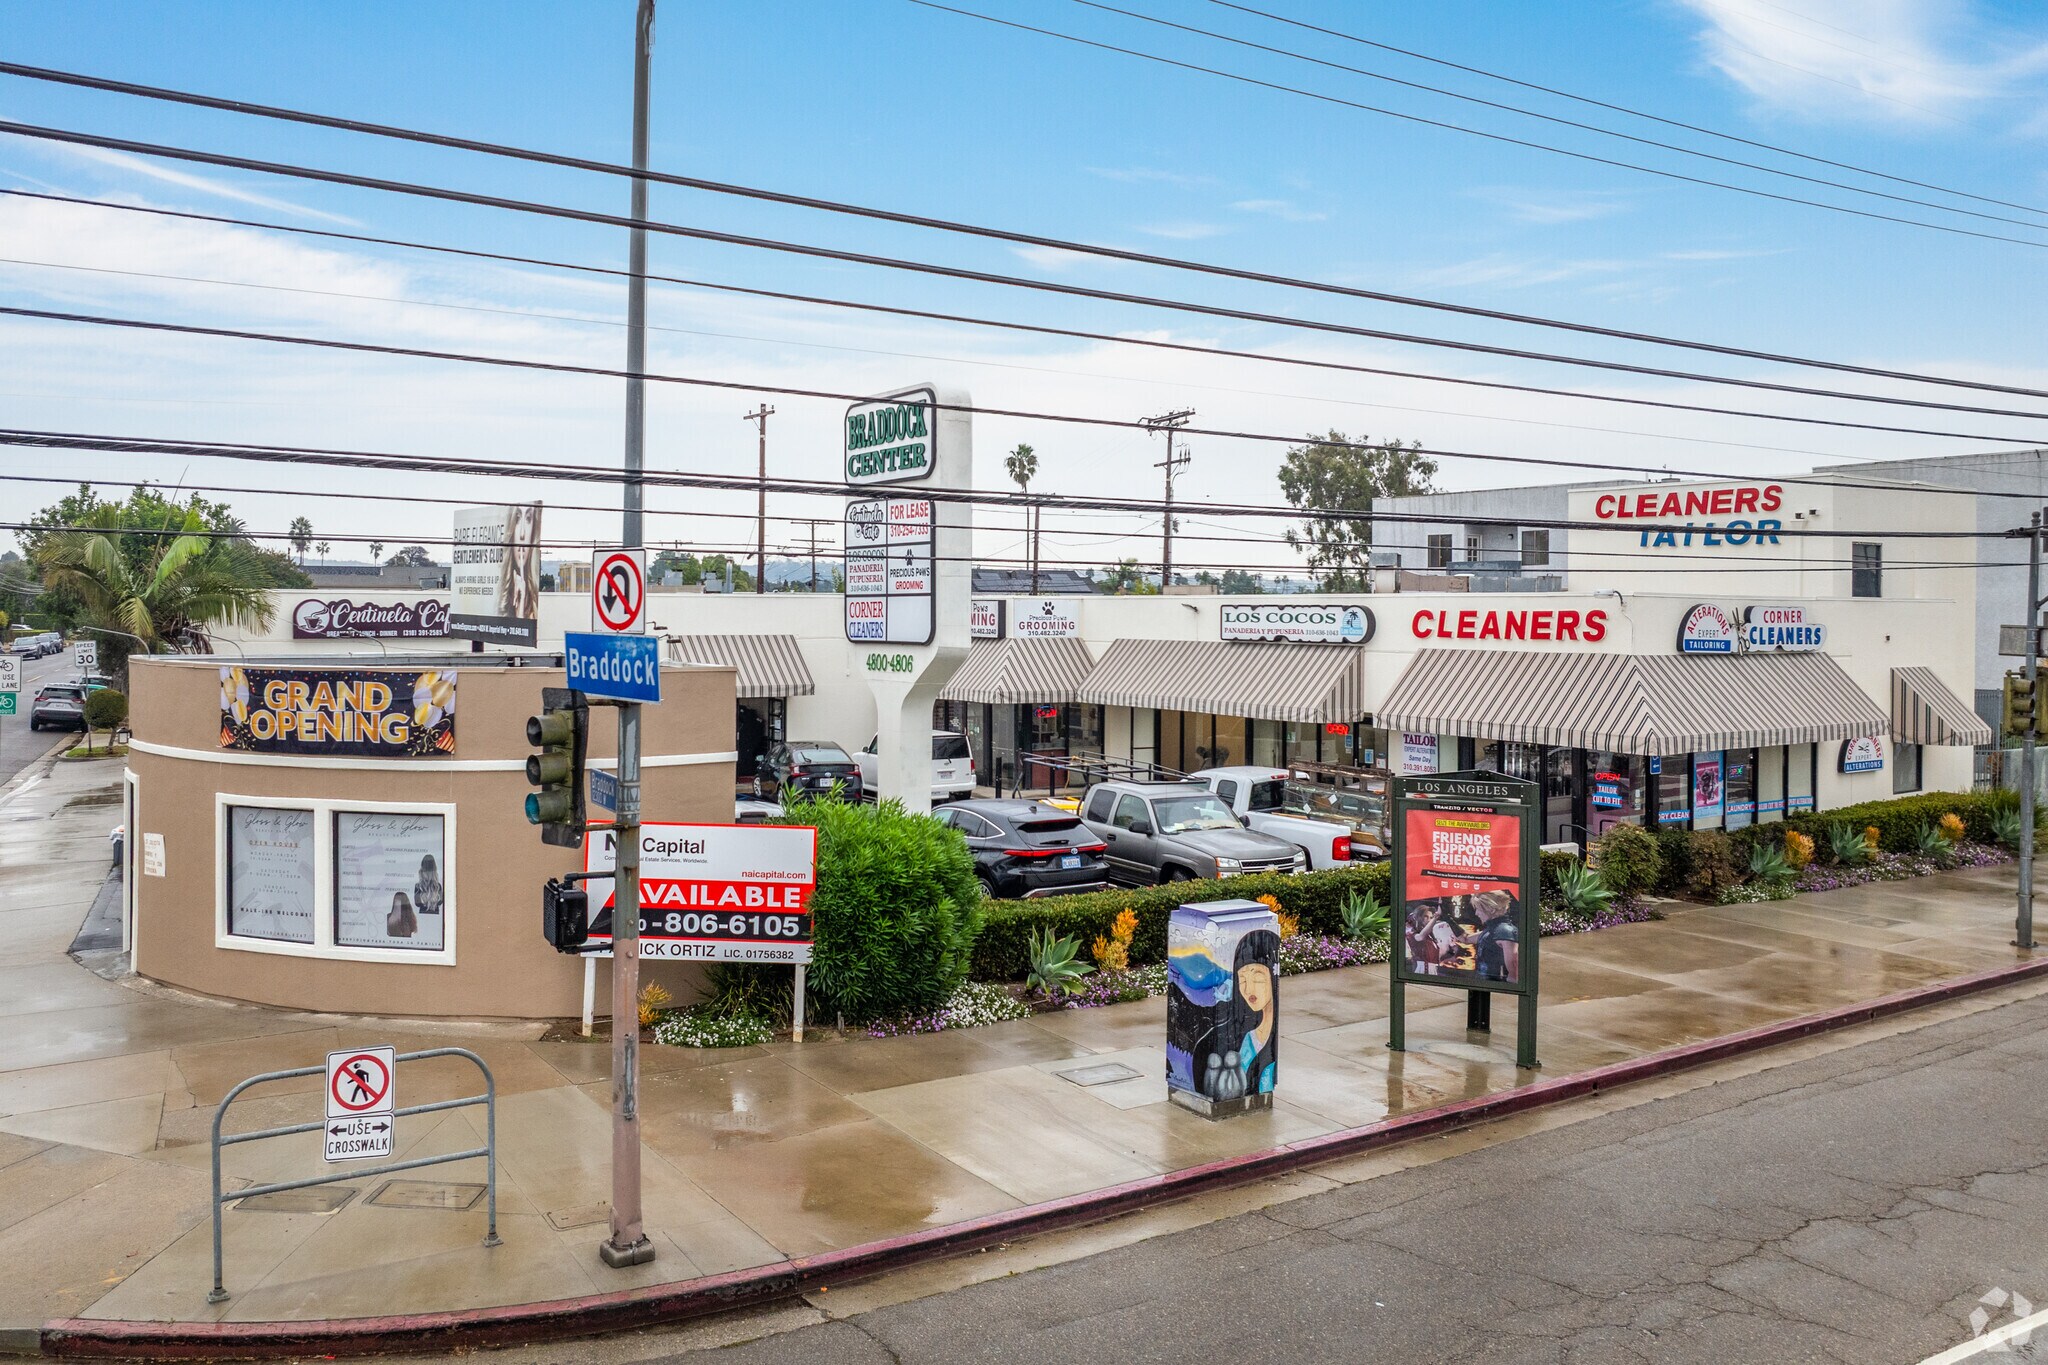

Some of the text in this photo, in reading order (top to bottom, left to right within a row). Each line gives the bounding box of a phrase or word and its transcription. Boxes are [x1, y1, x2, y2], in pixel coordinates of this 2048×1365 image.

[847, 399, 927, 451] BRADDOCK
[847, 442, 927, 477] CENTER
[1595, 485, 1783, 519] CLEANERS
[890, 502, 929, 520] FOR LEASE
[890, 523, 929, 537] 310-254-7333
[453, 548, 503, 564] GENTLEMEN'S CLUB
[848, 549, 885, 562] LOS COCOS
[849, 564, 884, 573] PANADERIA
[890, 568, 915, 578] PRECIOUS
[849, 574, 884, 584] PUPUSERIA
[895, 581, 924, 590] GROOMING
[849, 601, 884, 618] CORNER
[330, 602, 450, 634] Centinela Caf
[1224, 612, 1336, 624] LOS COCOS
[1687, 605, 1730, 636] ALTERATIONS
[1763, 610, 1802, 624] CORNER
[849, 621, 884, 639] CLEANERS
[1019, 621, 1075, 630] GROOMING
[1224, 627, 1260, 635] PANADERIA
[1266, 628, 1305, 636] PUPUSERIA
[1411, 609, 1609, 642] CLEANERS
[1698, 629, 1720, 638] EXPERT
[1749, 626, 1822, 645] CLEANERS
[1689, 641, 1726, 649] TAILORING
[78, 654, 94, 664] 30
[866, 653, 914, 673] 4800-4806
[568, 647, 656, 687] Braddock
[263, 680, 393, 713] GRAND
[250, 709, 410, 744] OPENING
[1326, 723, 1348, 736] OPEN
[1403, 734, 1437, 747] TAILOR
[1846, 761, 1881, 770] ALTERATIONS
[1594, 772, 1620, 781] OPEN
[1417, 782, 1508, 796] LOS ANGELES
[1598, 785, 1618, 794] TAILOR
[1727, 804, 1752, 812] LAUNDRY
[245, 810, 309, 831] Gloss & Glow
[1670, 812, 1690, 820] CLEAN
[352, 815, 430, 836] Gloss & Glow
[1432, 831, 1491, 846] FRIENDS
[642, 837, 705, 857] Capital
[1432, 843, 1492, 857] SUPPORT
[1432, 853, 1491, 868] FRIENDS
[741, 870, 806, 881] naicapital.com
[240, 907, 312, 918] WALK-INS WELCOME!
[670, 943, 716, 958] ORTIZ
[724, 948, 744, 958] LIC.
[746, 950, 794, 960] 01756382
[347, 1122, 372, 1136] USE
[328, 1138, 388, 1154] CROSSWALK
